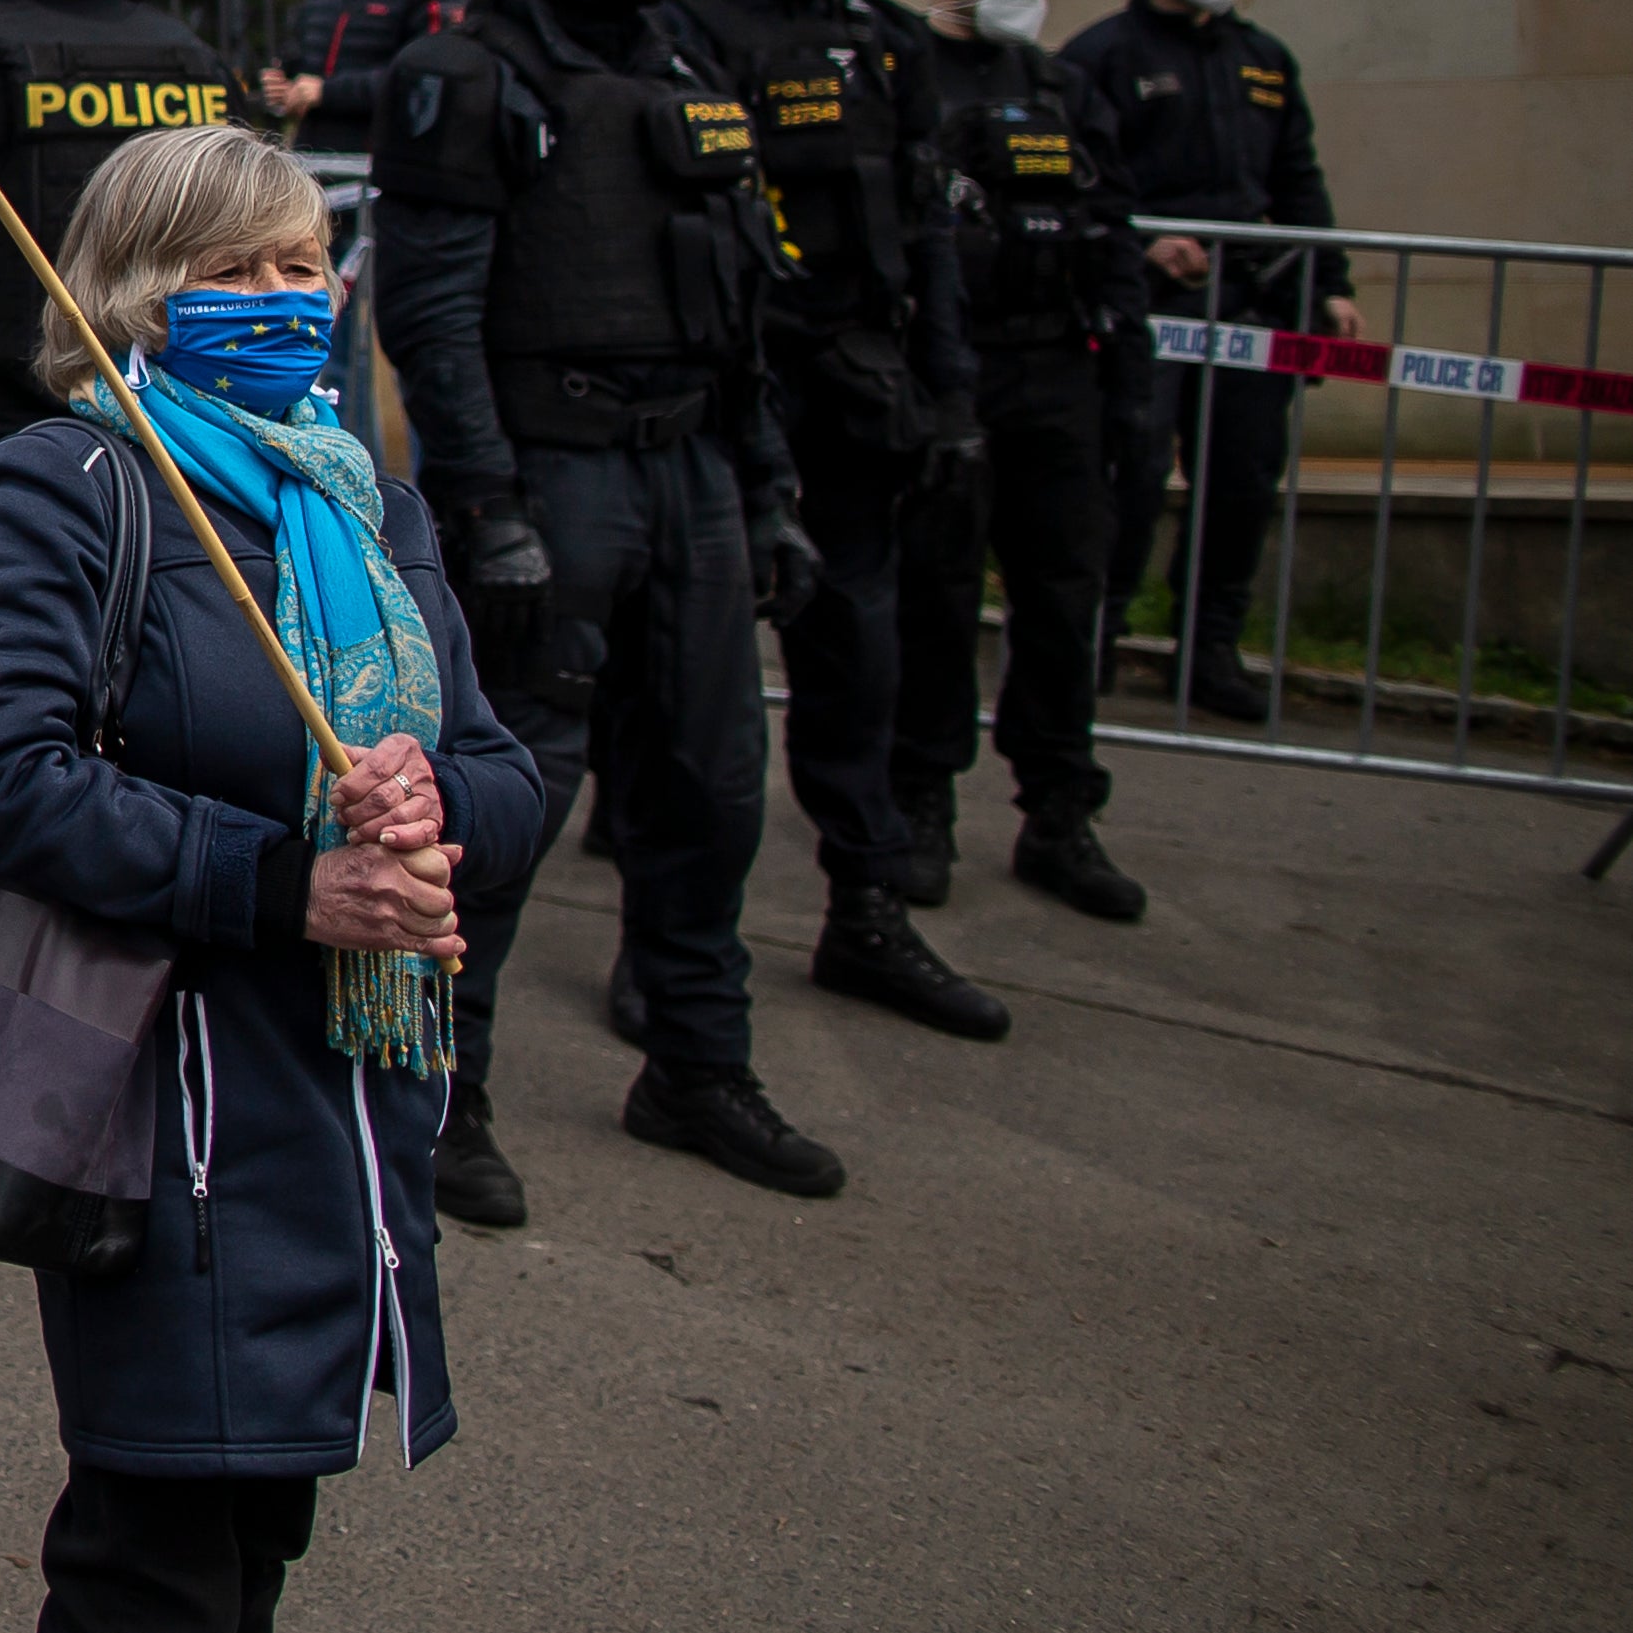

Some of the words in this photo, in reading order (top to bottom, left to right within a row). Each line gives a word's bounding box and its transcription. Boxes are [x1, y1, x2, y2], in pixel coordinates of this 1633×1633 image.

[27, 81, 229, 129] POLICIE
[1158, 324, 1222, 360] POLICE
[1229, 328, 1253, 360] ČR
[1402, 352, 1473, 390] POLICIE
[1478, 359, 1503, 393] ČR
